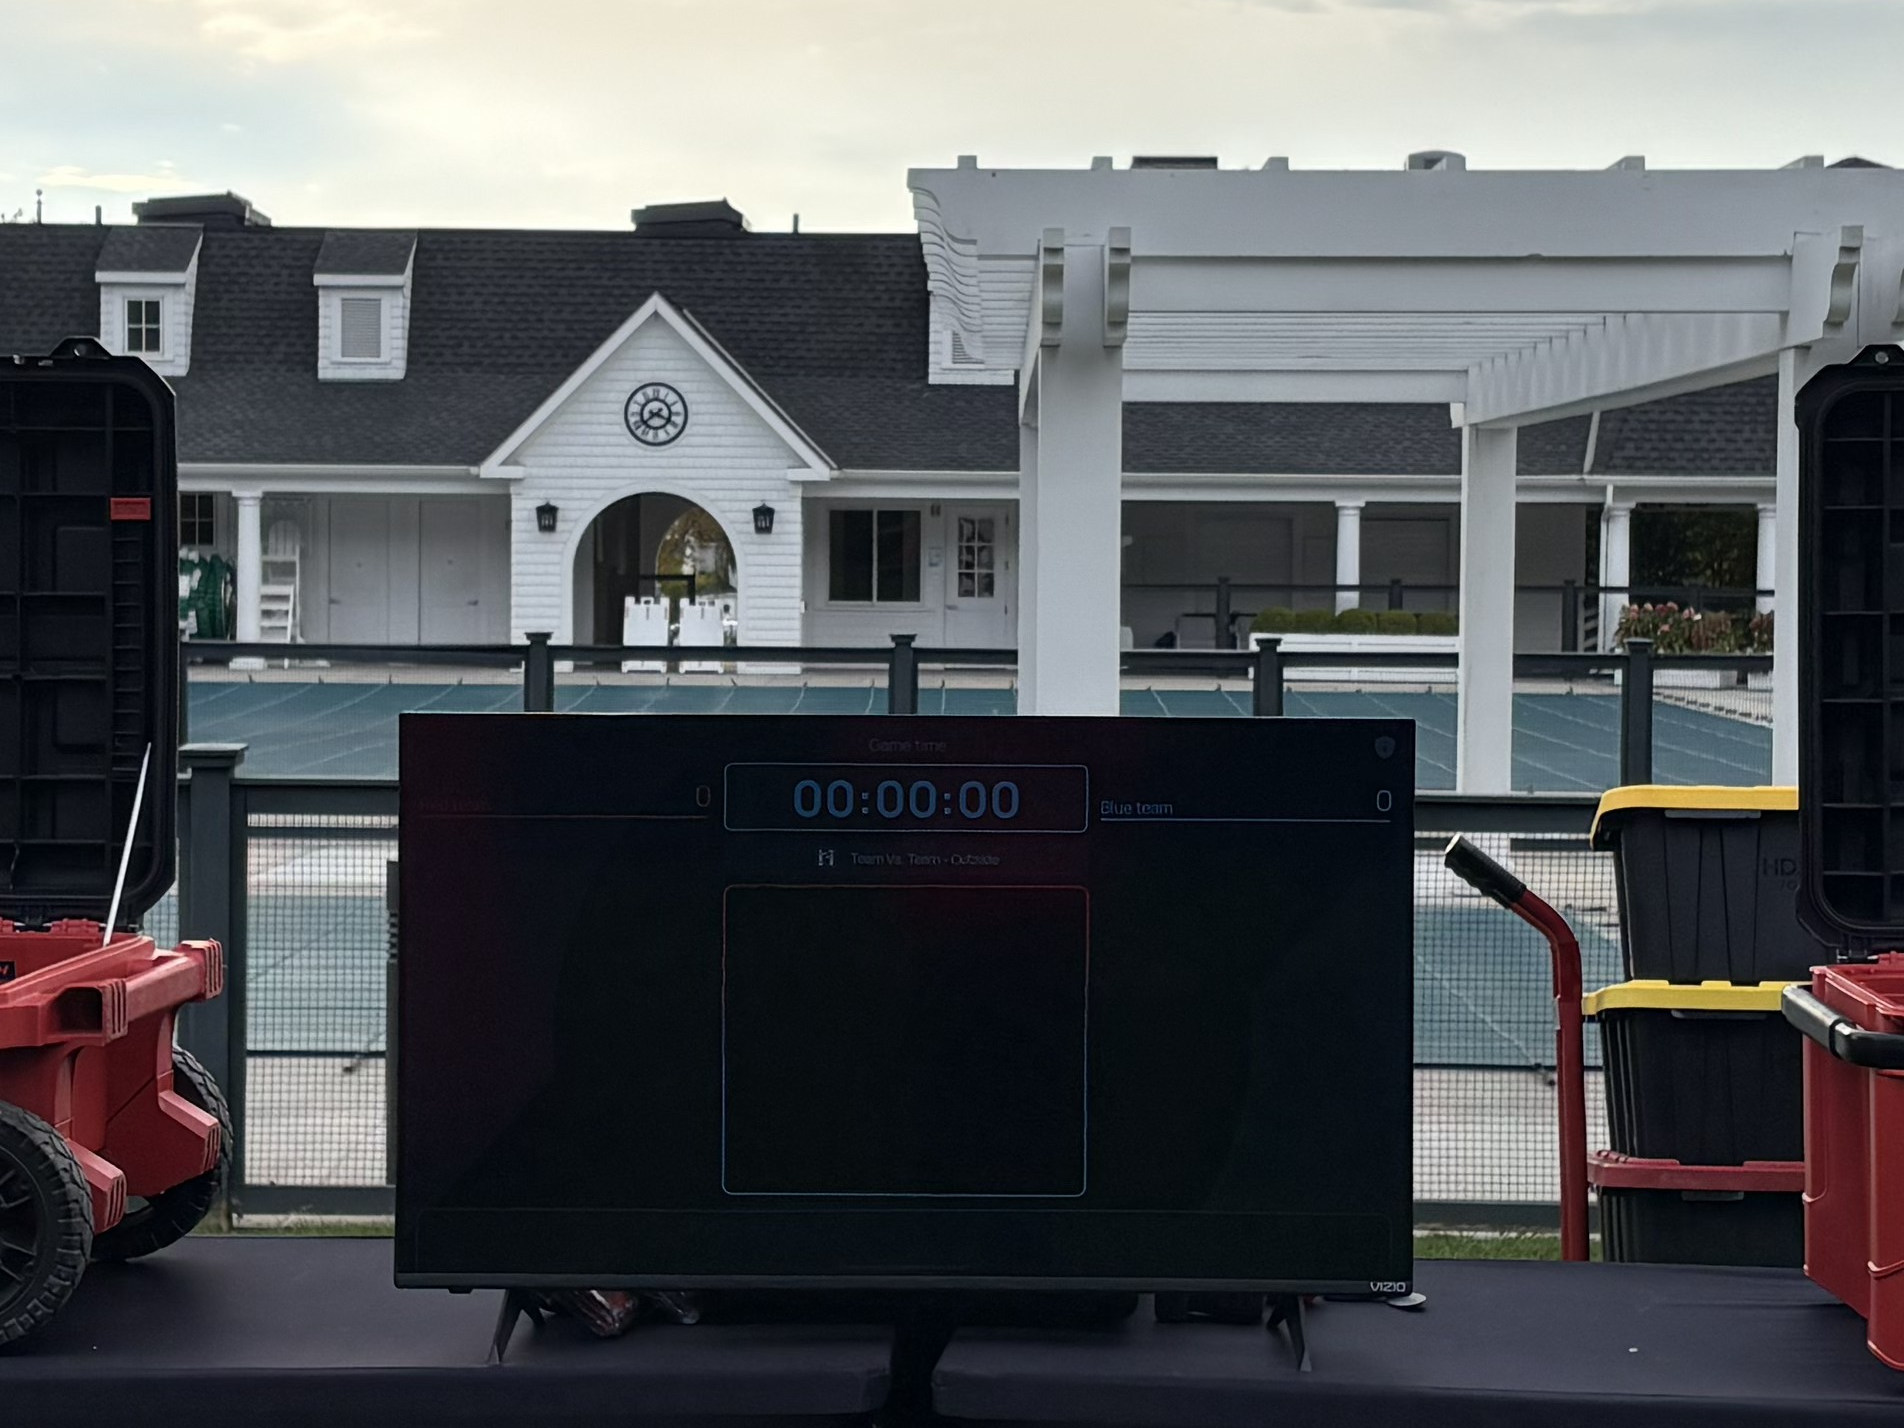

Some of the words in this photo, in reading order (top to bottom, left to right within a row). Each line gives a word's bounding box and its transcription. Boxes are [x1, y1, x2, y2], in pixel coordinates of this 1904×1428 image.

[696, 784, 712, 808] 0
[792, 778, 1021, 820] 00:00:00
[1100, 799, 1133, 815] Blue
[1135, 801, 1174, 815] team
[1376, 789, 1393, 812] 0
[1369, 1281, 1407, 1293] VIZIO
